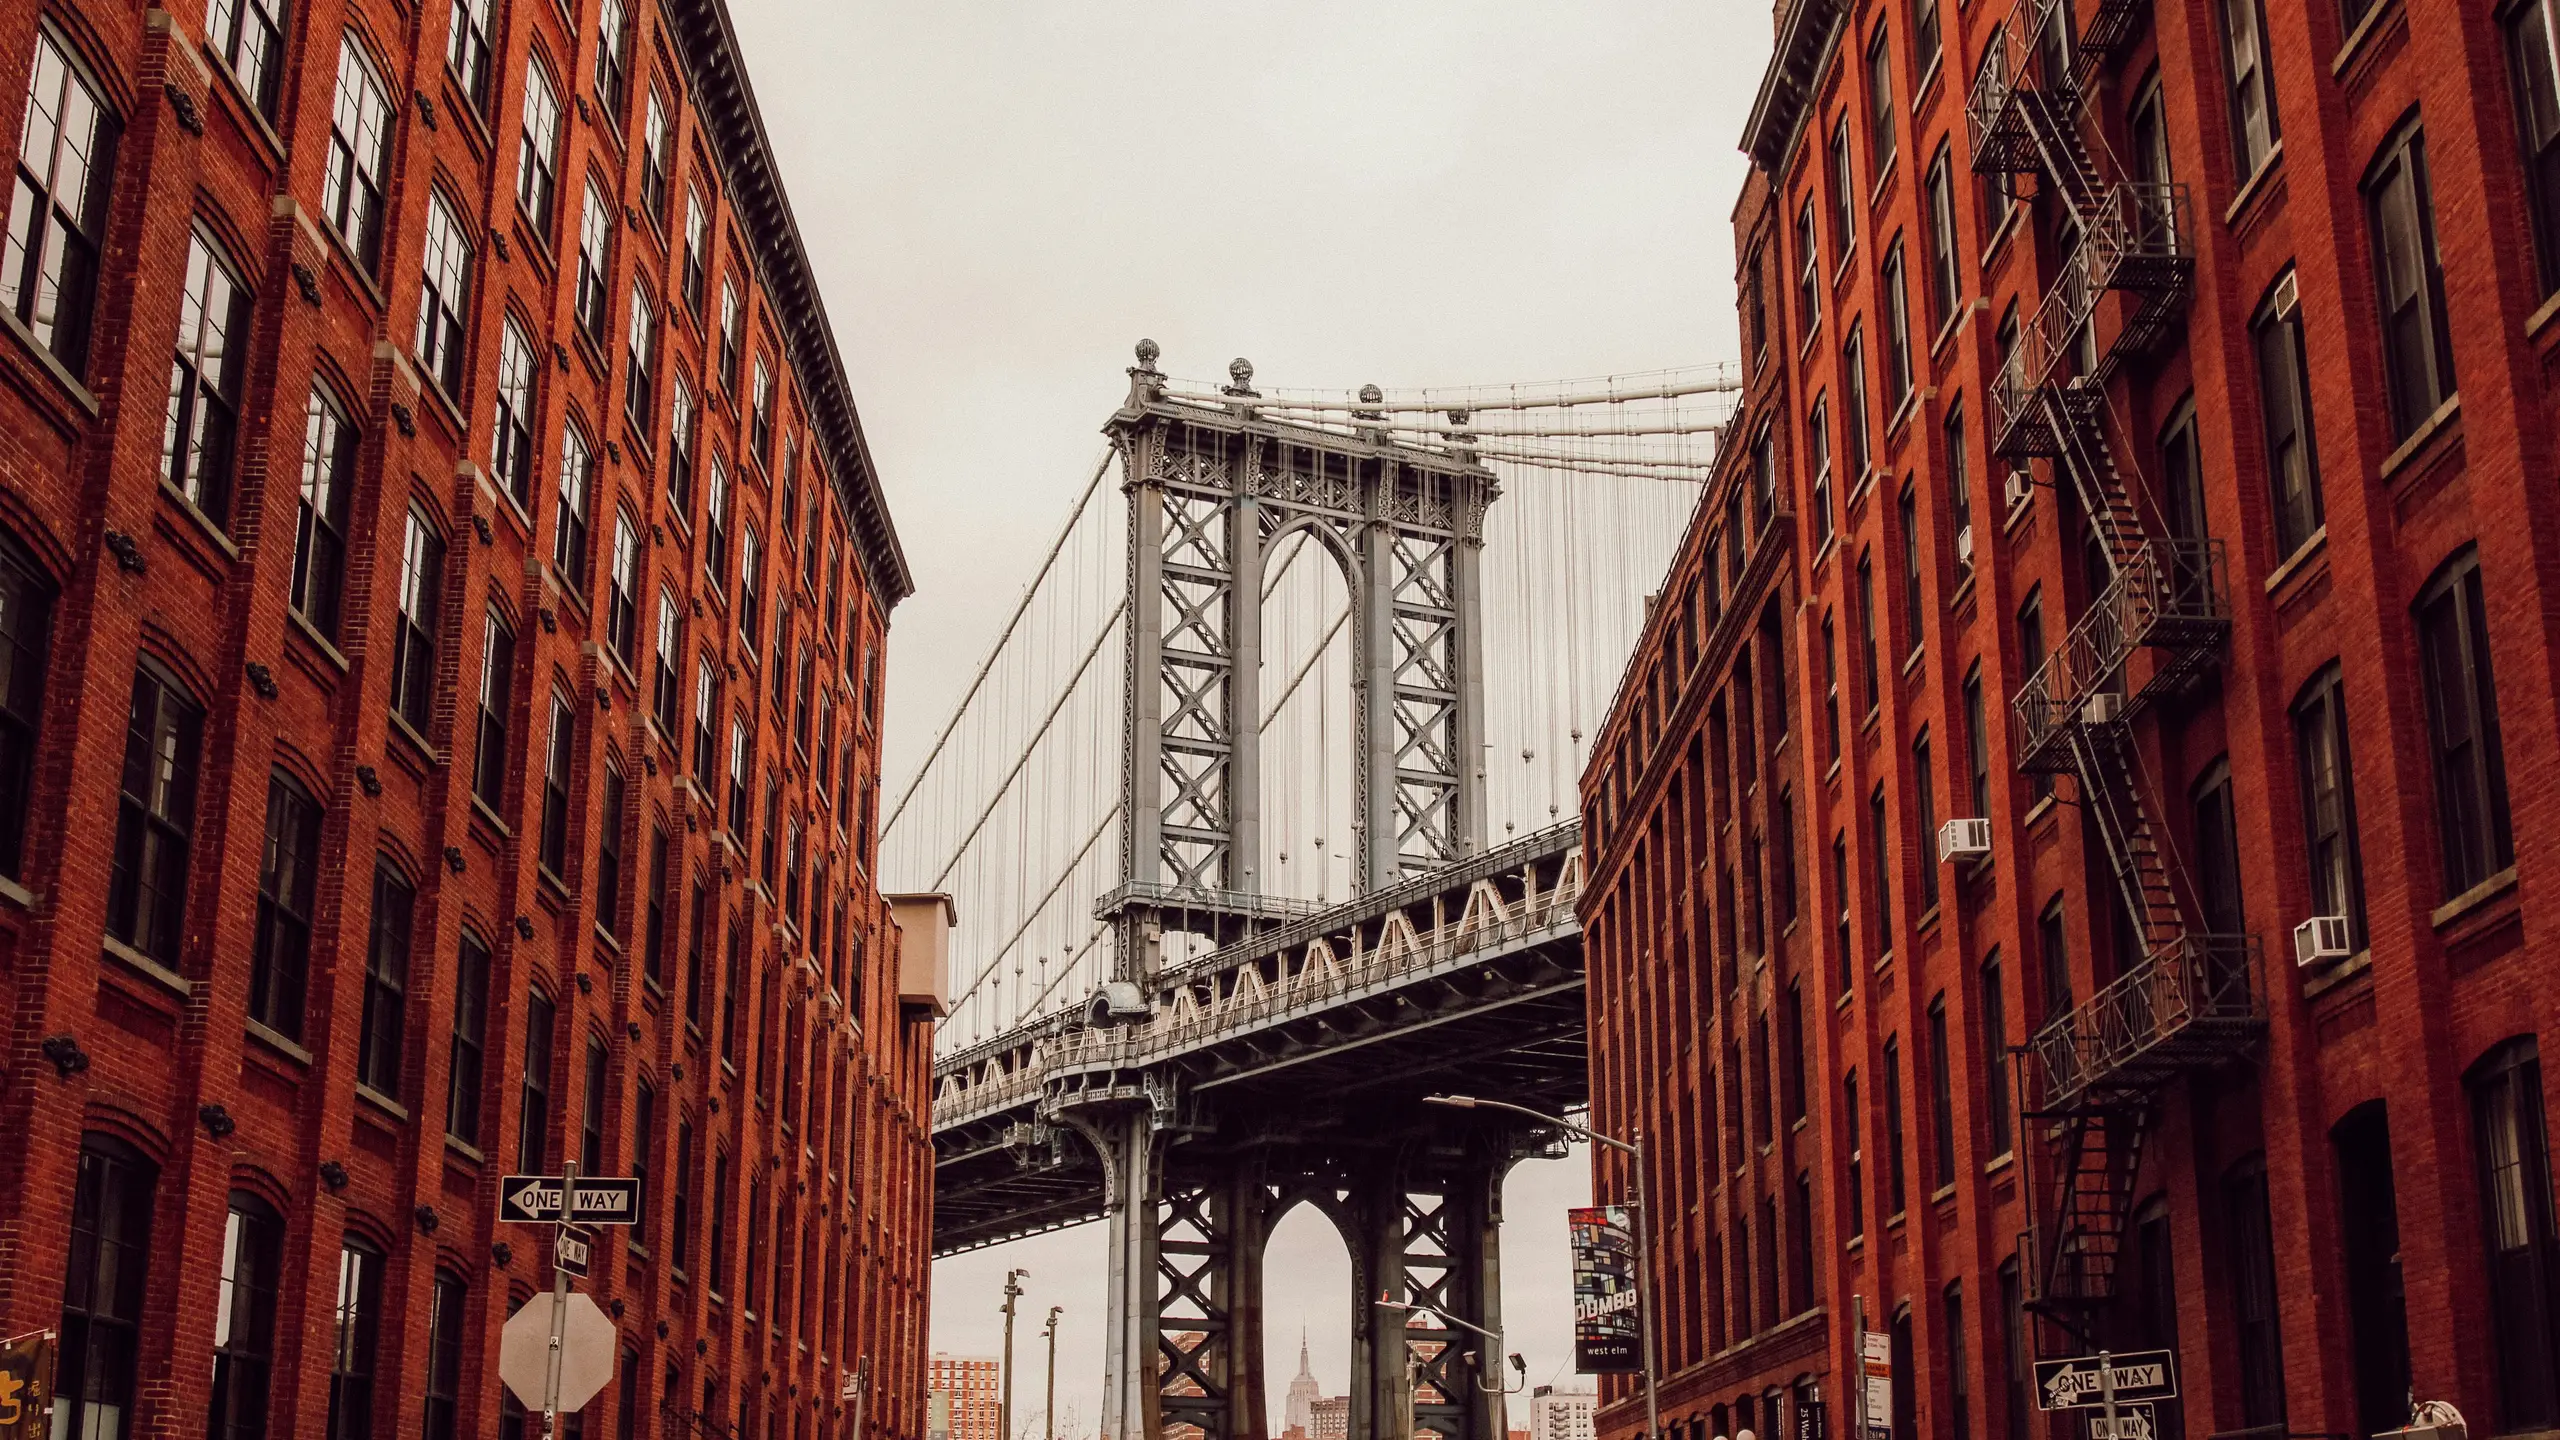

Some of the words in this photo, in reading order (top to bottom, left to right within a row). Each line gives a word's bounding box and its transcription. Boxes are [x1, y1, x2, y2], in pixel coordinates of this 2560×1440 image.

[523, 1191, 560, 1208] ONE
[579, 1192, 620, 1209] WAY
[560, 1237, 570, 1257] ONE
[573, 1243, 586, 1262] WAY
[1575, 1288, 1637, 1322] DUMBO
[1587, 1346, 1608, 1355] west
[1611, 1345, 1628, 1355] elm
[2058, 1372, 2097, 1394] ONE
[2114, 1366, 2155, 1388] WAY
[1800, 1408, 1809, 1418] 25
[2095, 1419, 2108, 1438] ON
[2122, 1419, 2144, 1437] WAY
